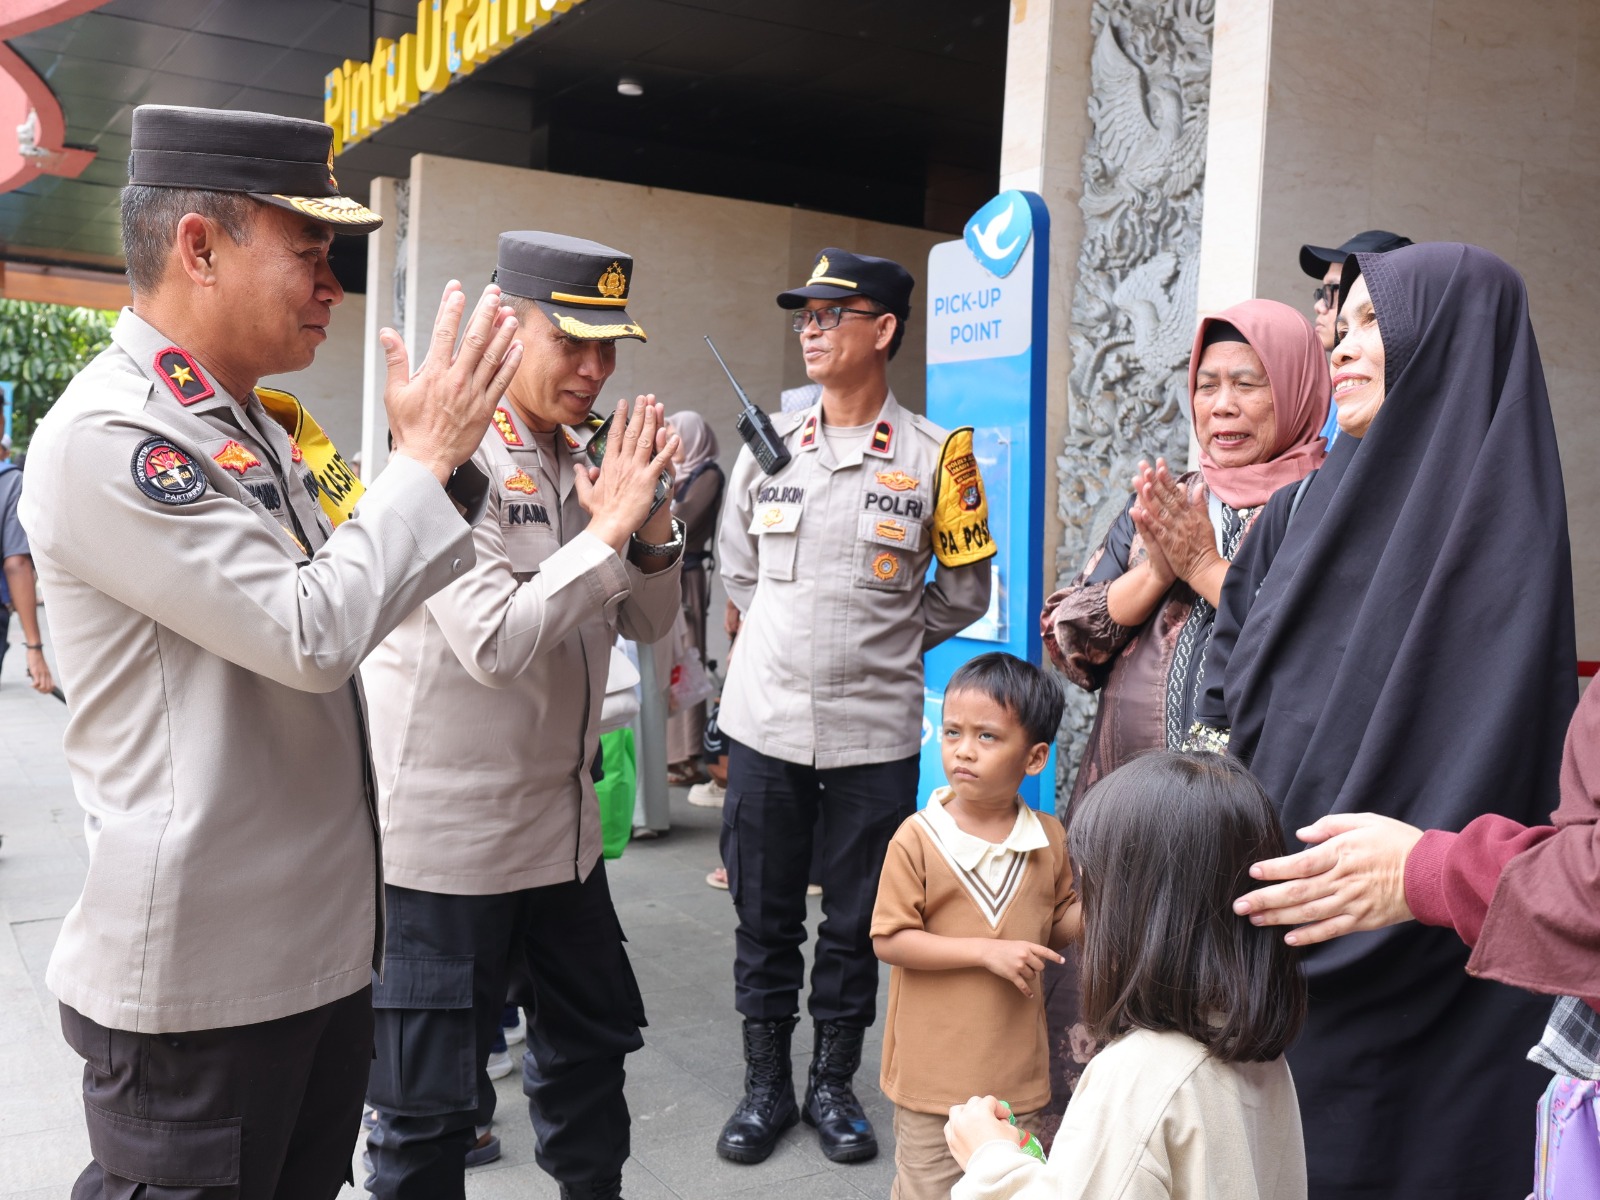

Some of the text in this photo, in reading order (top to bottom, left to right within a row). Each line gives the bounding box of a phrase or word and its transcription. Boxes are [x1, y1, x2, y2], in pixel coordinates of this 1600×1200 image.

[324, 0, 574, 155] Pintu Utam
[934, 287, 1002, 316] PICK-UP
[950, 319, 1002, 345] POINT
[864, 492, 922, 518] POLRI
[939, 530, 960, 556] PA
